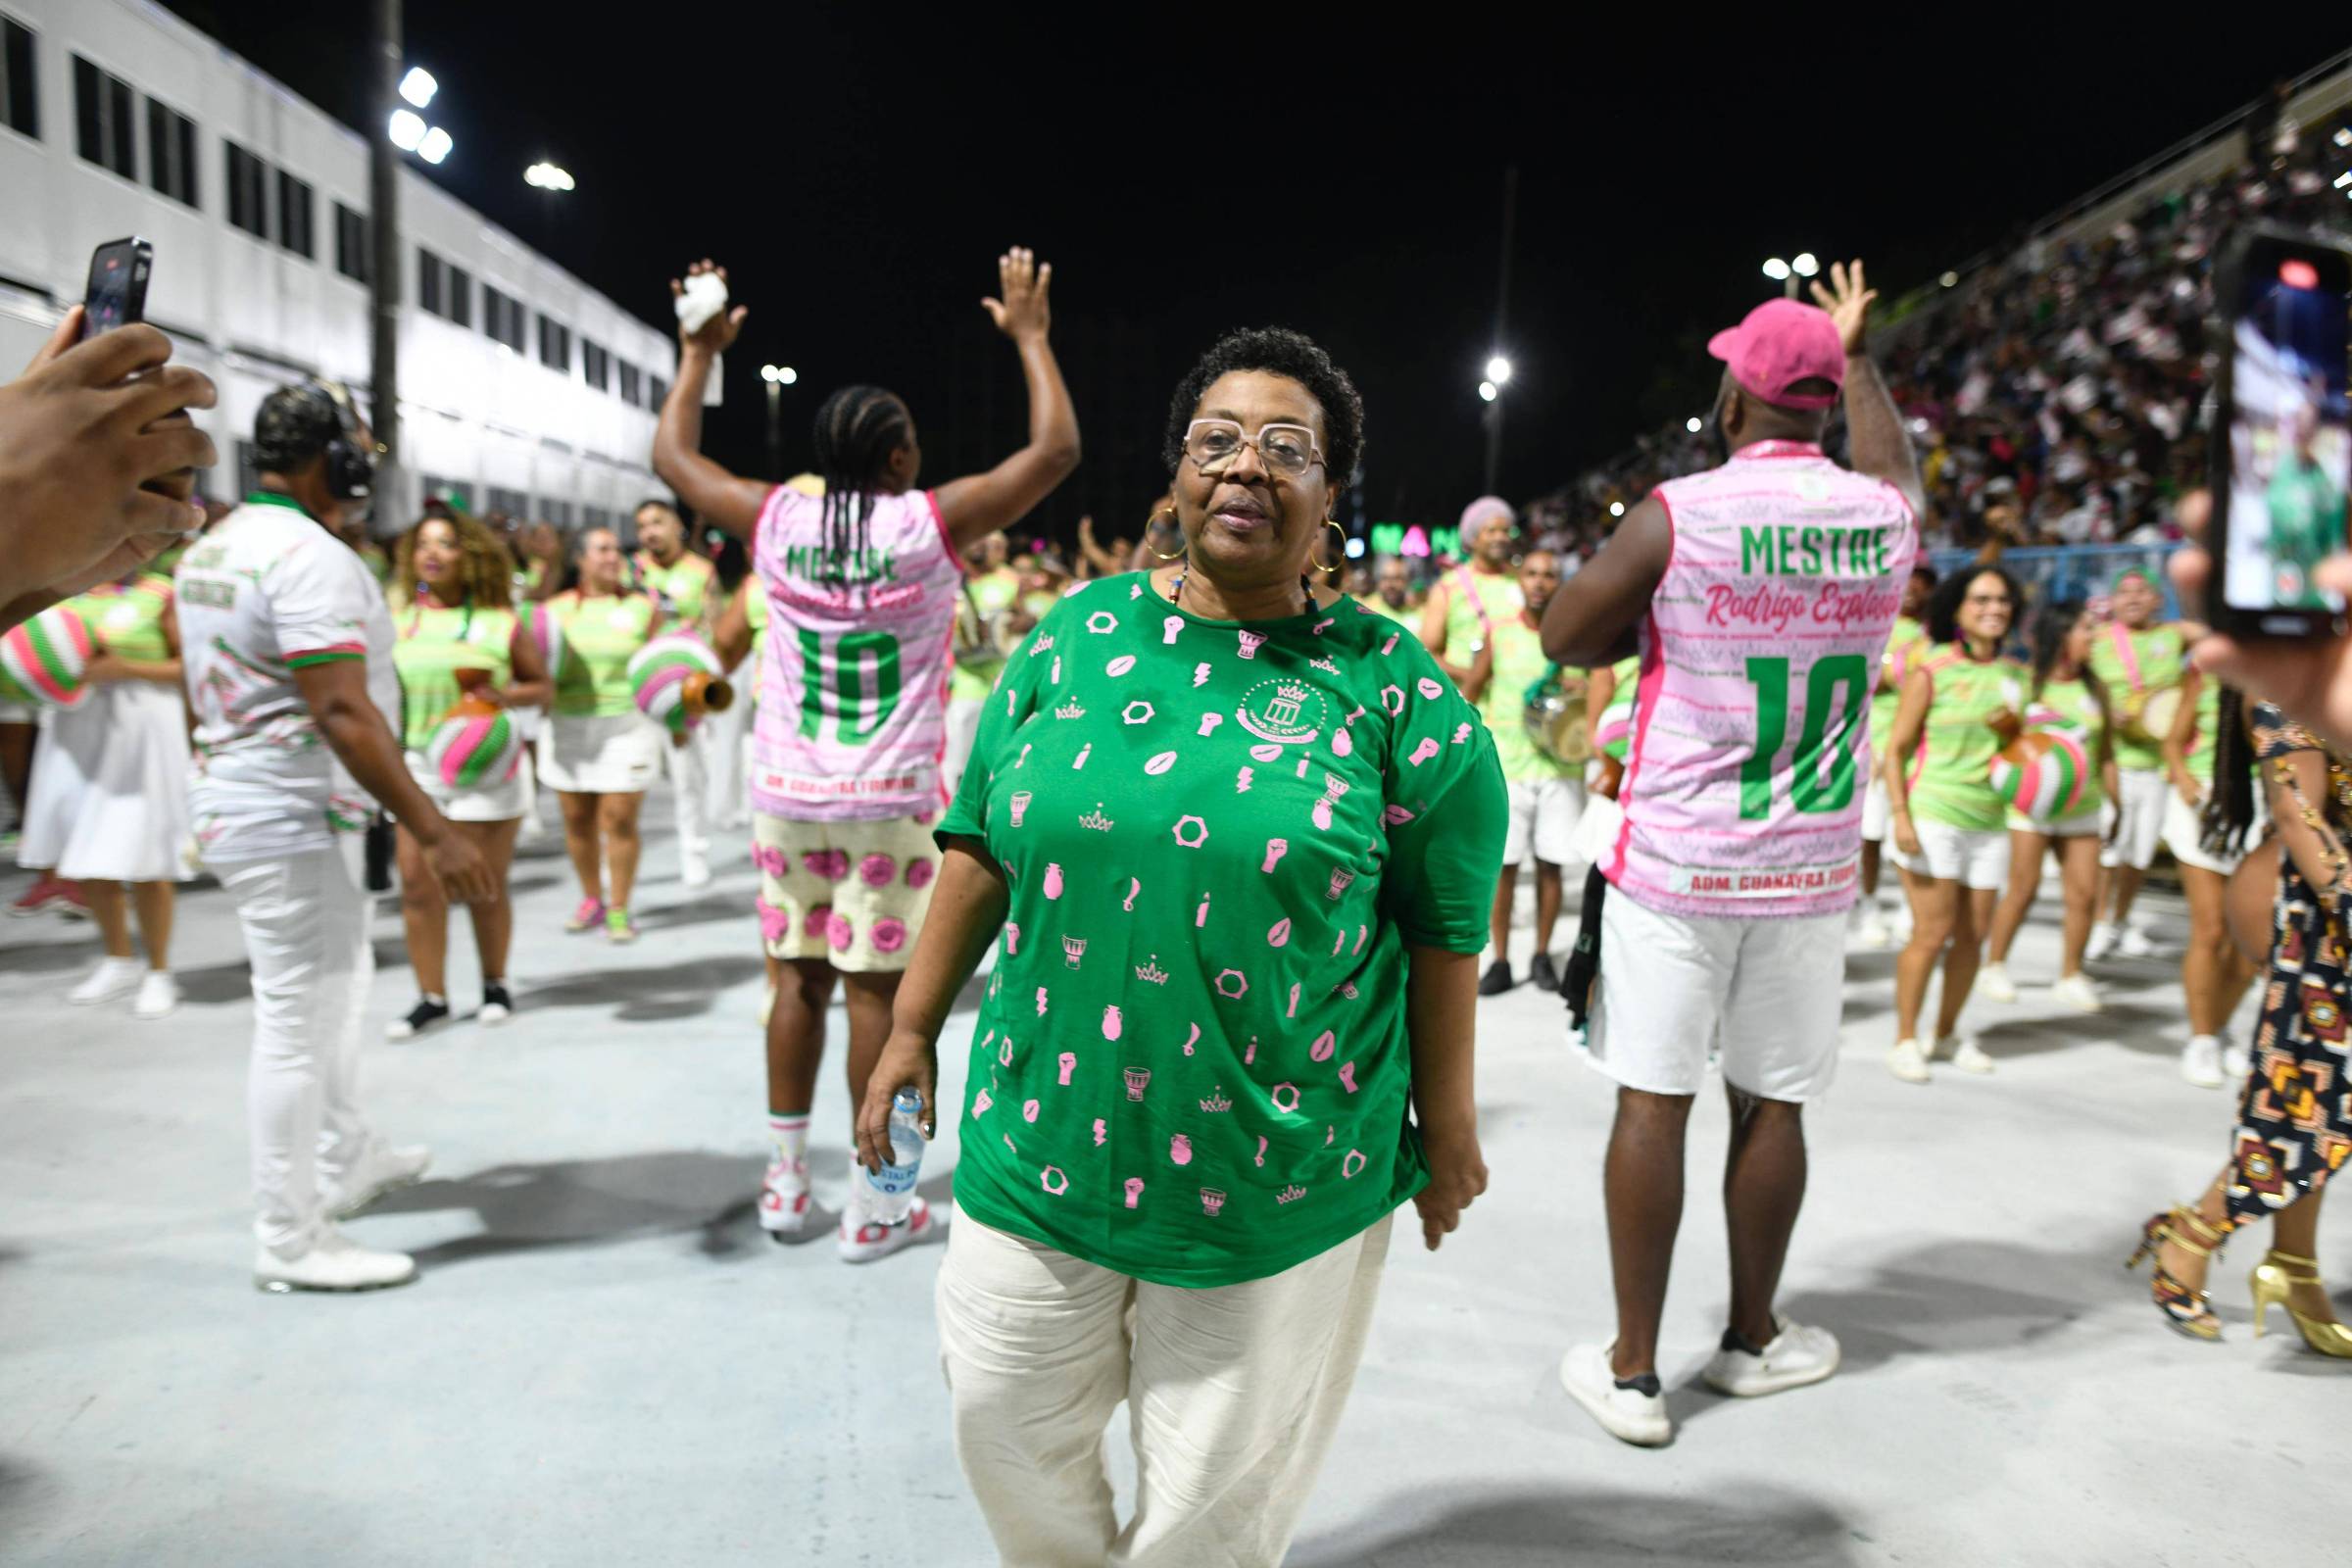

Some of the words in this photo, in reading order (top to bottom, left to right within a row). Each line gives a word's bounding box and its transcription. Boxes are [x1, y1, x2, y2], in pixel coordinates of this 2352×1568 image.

[1740, 525, 1891, 576] MESTRE
[1705, 583, 1807, 633] Rodrigo
[798, 628, 901, 747] 10
[1740, 655, 1868, 820] 10
